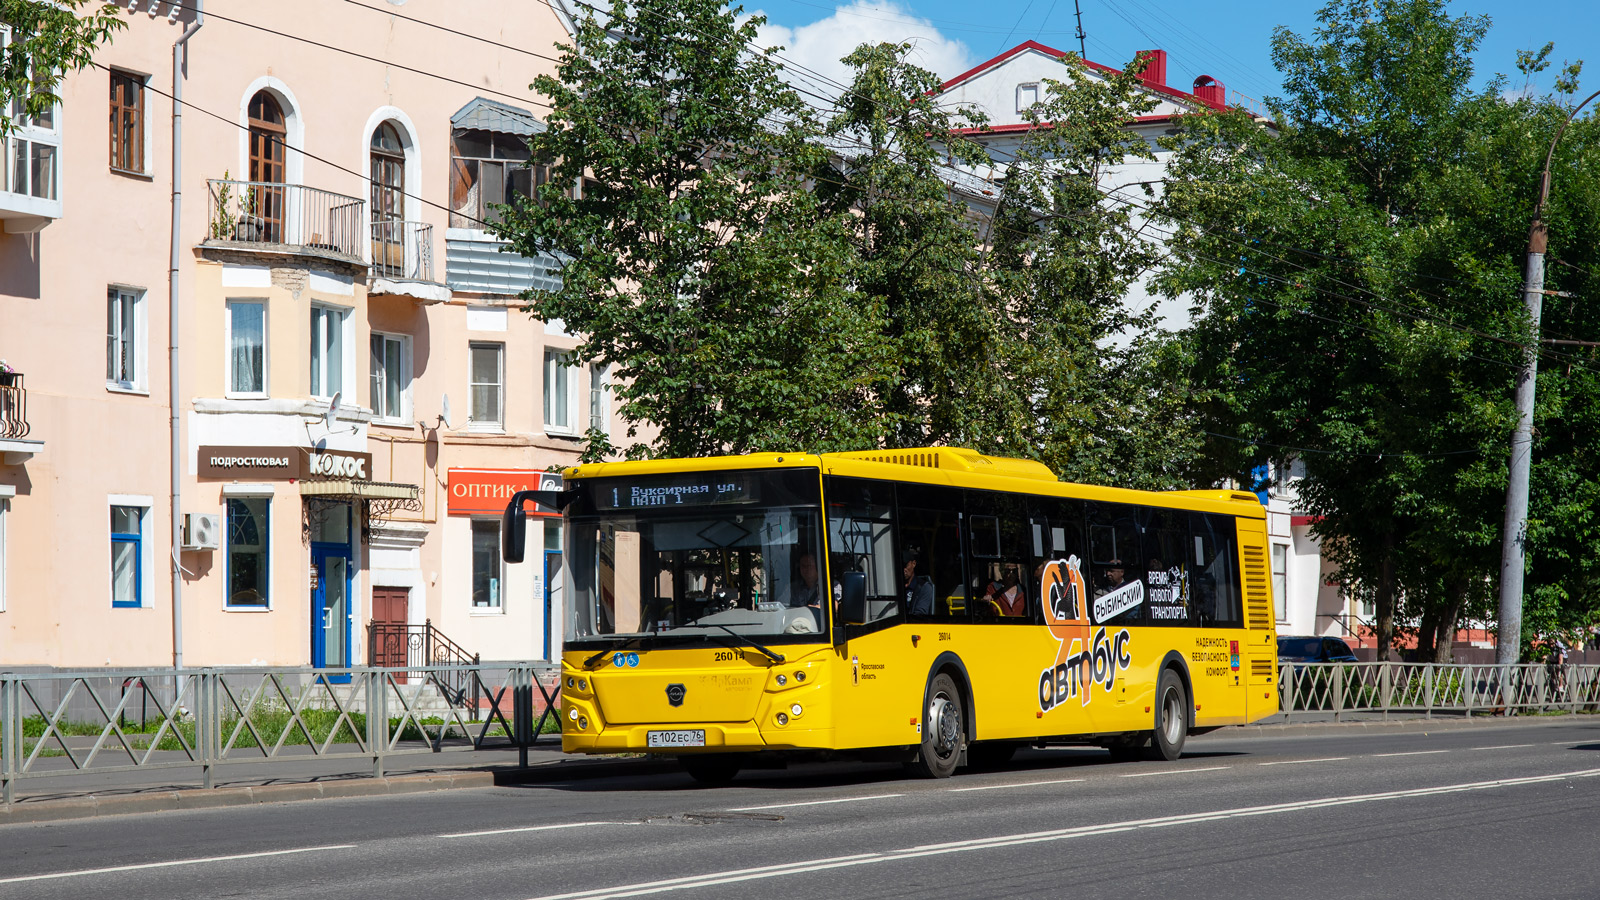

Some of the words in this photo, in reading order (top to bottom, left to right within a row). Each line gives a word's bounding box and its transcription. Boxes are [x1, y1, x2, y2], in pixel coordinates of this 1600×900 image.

[210, 457, 289, 469] ПОДРОСТКОВАЯ
[310, 453, 366, 478] КОКОС
[612, 487, 619, 507] 1
[631, 484, 709, 498] Буксирная
[717, 483, 742, 493] ул.
[631, 495, 666, 506] ПАТП
[675, 494, 683, 504] 1
[1148, 571, 1168, 584] ВРЕМЯ
[1095, 582, 1142, 620] РЫБИНСКИЙ
[1149, 588, 1172, 602] НОВОГО
[1150, 606, 1188, 619] ТРАНСПОРТА
[938, 632, 951, 641] 26014
[1195, 637, 1228, 648] НАДЕЖНОСТЬ
[714, 651, 745, 662] 26014
[1192, 652, 1228, 662] БЕЗОПАСНОСТЬ
[1039, 626, 1131, 712] автобус
[1206, 667, 1228, 676] КОМФОРТ
